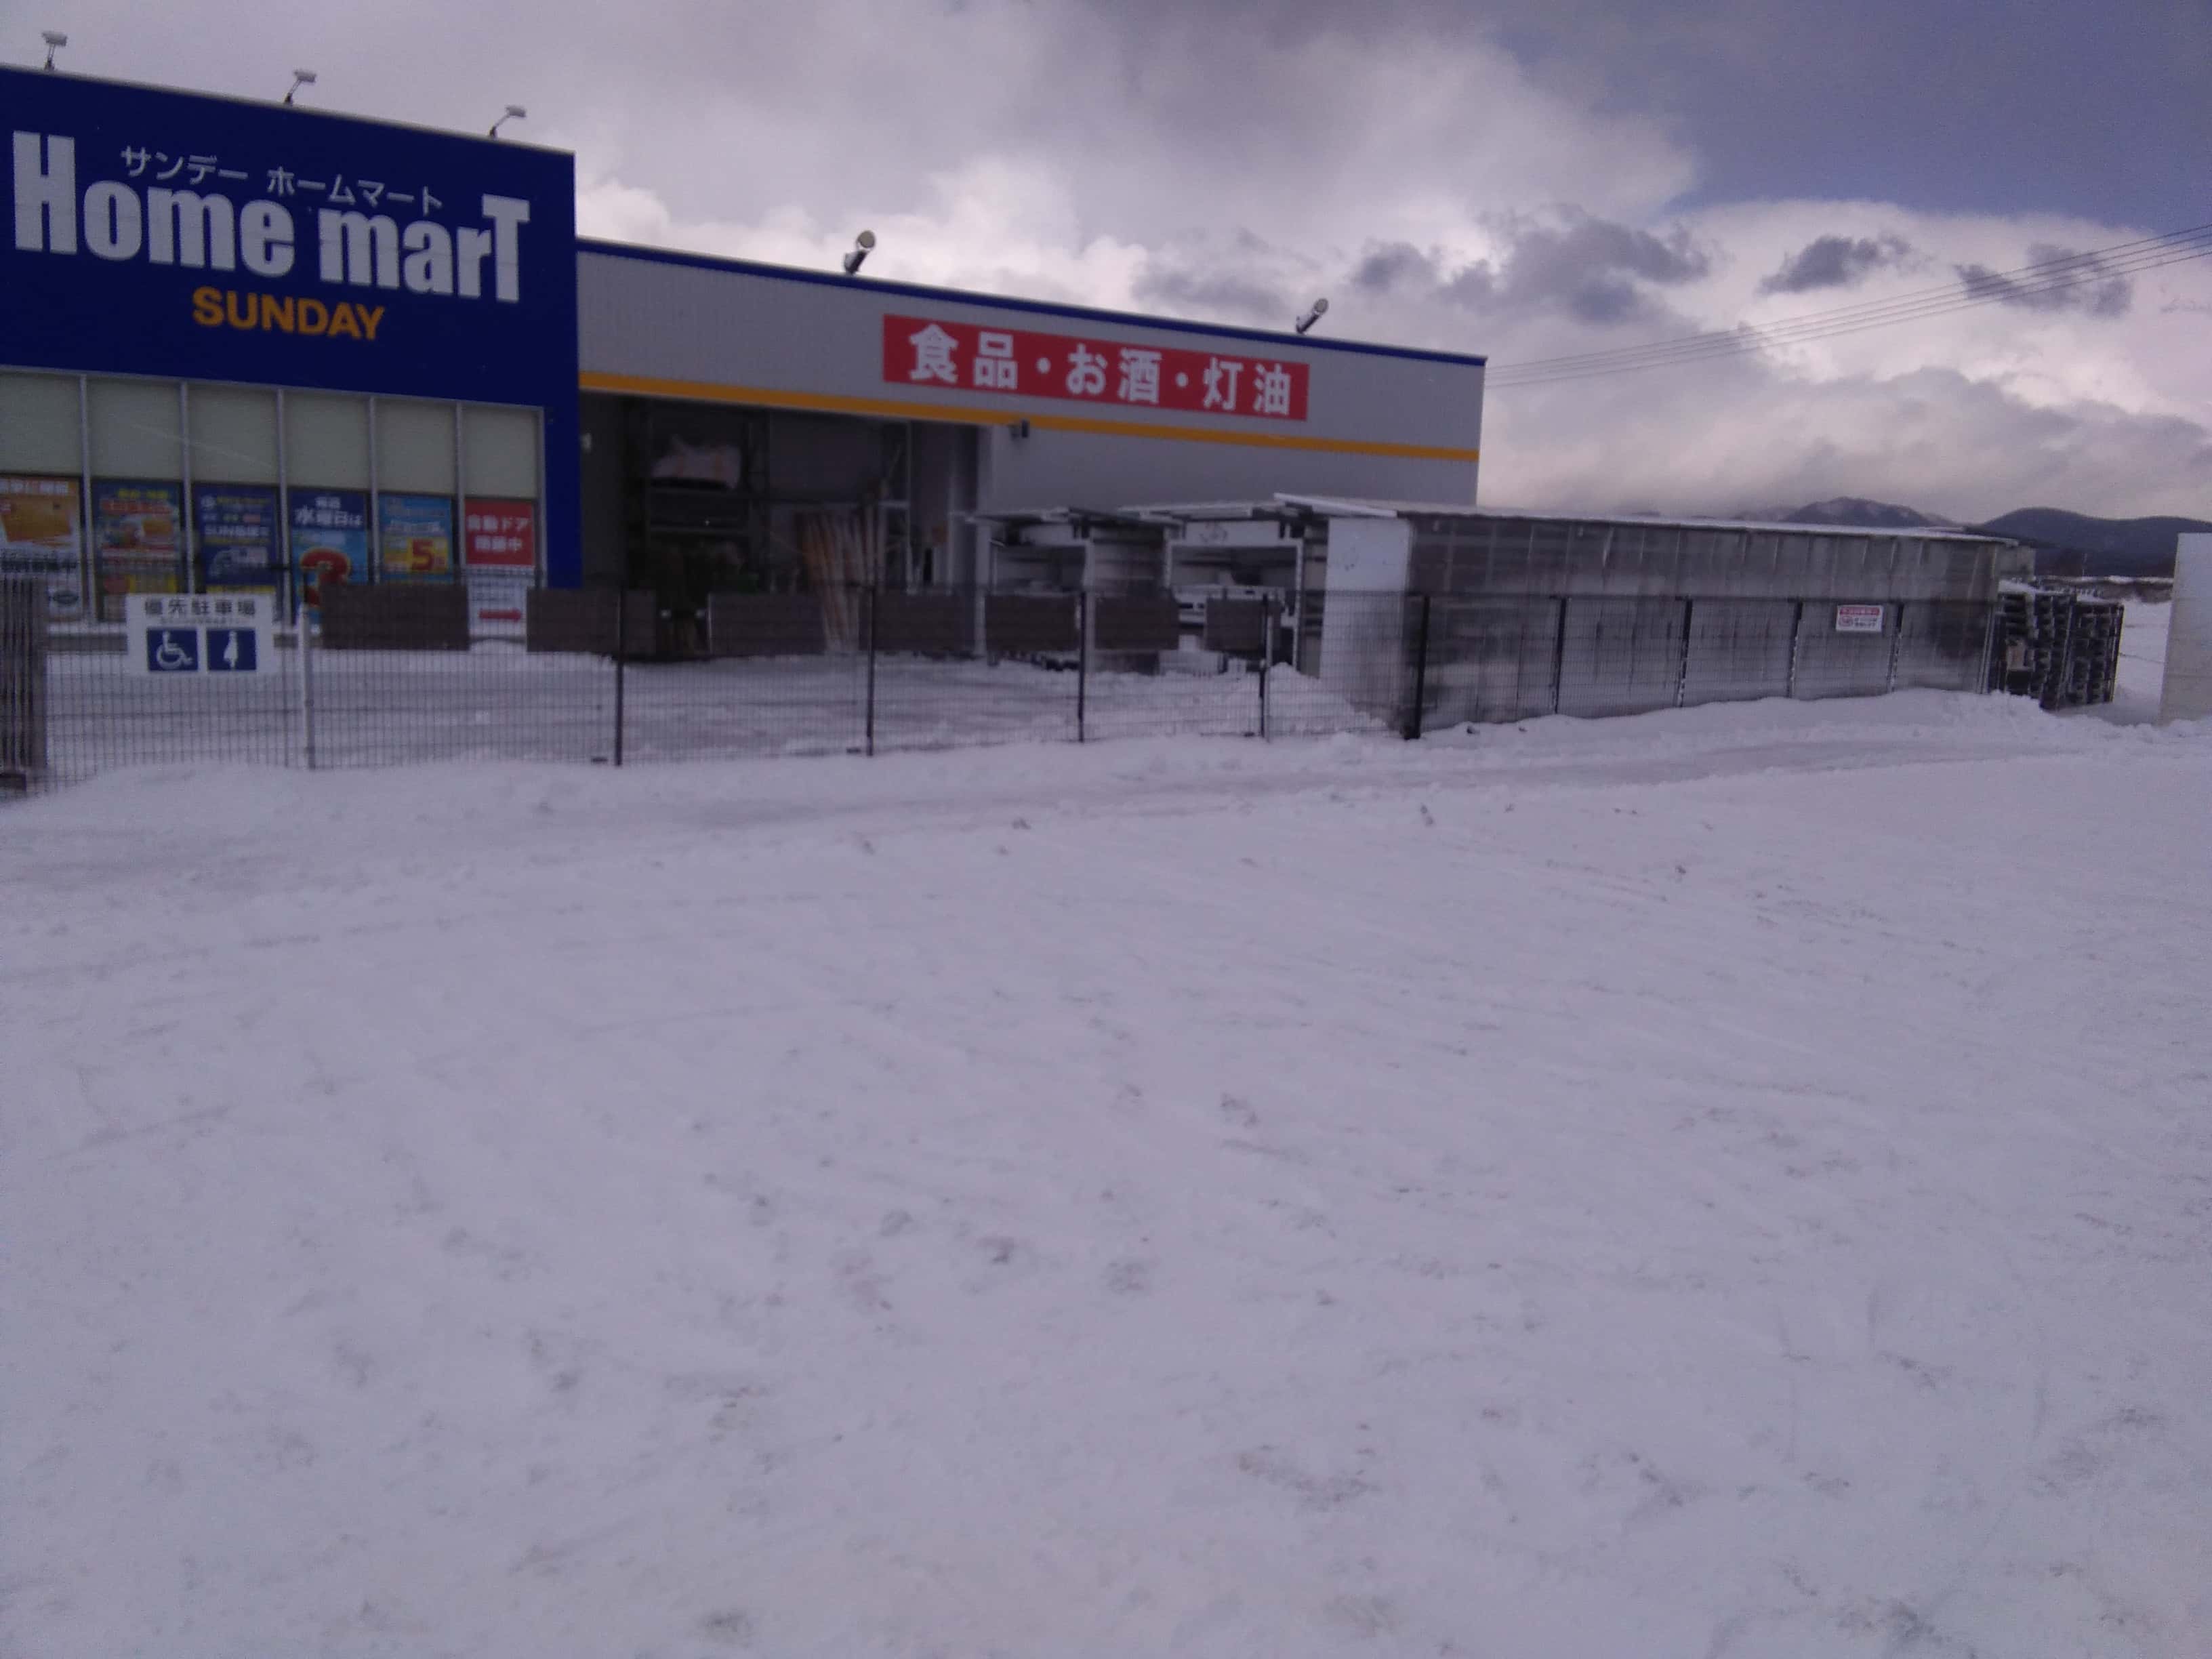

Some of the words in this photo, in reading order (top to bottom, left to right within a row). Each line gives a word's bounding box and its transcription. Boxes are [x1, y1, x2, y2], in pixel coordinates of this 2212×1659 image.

[13, 130, 295, 278] Home
[121, 145, 248, 184] サンデー
[268, 166, 443, 216] ホームマート
[192, 286, 386, 341] SUNDAY
[909, 323, 1290, 415] 食品・お酒・灯油
